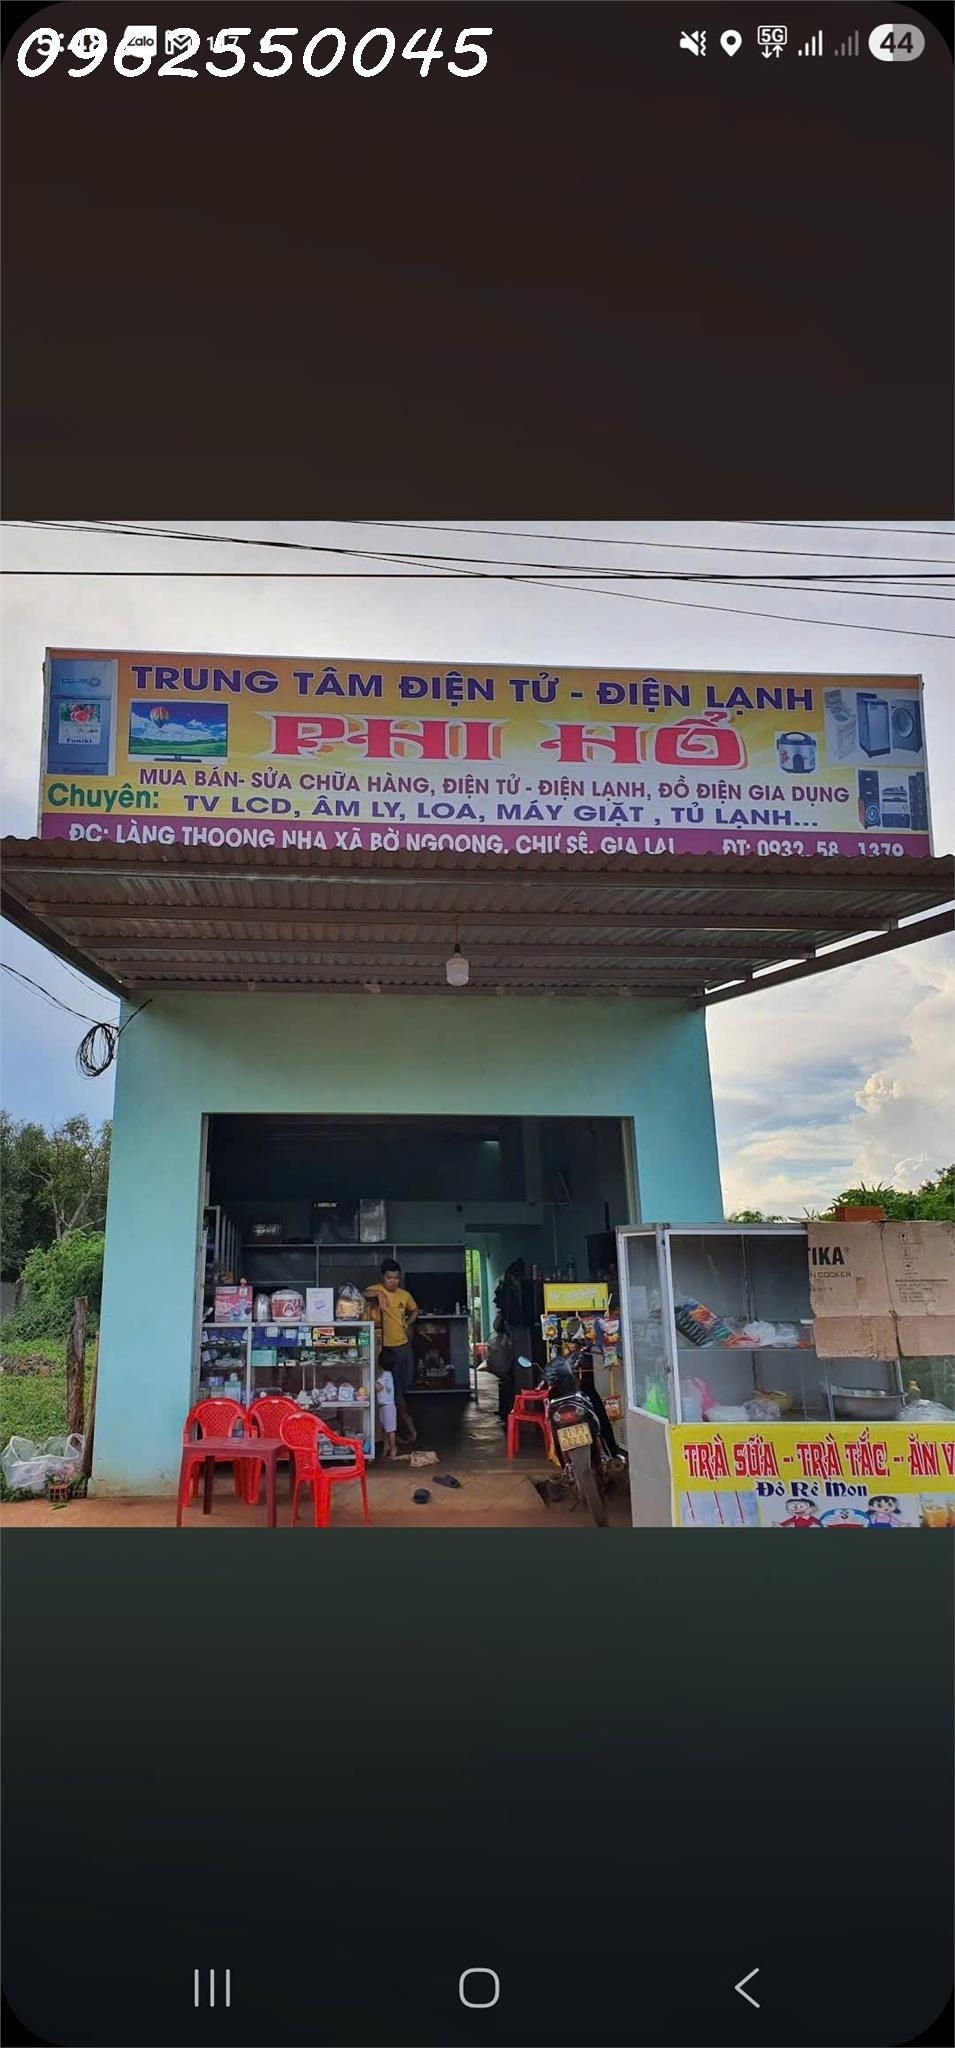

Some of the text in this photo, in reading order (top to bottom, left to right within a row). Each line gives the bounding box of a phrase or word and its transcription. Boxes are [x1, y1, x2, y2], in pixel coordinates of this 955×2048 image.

[131, 665, 279, 694] TRUNG
[293, 666, 383, 698] TÂM
[399, 670, 494, 707] ĐIỆN
[509, 672, 560, 702] TỬ
[596, 677, 691, 713] ĐIỆN
[706, 685, 813, 716] LẠNH
[271, 711, 744, 767] PHI HỔ
[47, 783, 159, 813] Chuyên:
[183, 795, 221, 812] TV
[231, 796, 301, 818] LCD,
[312, 795, 360, 817] ÂM
[371, 801, 406, 821] LY,
[417, 802, 485, 823] LOA,
[496, 800, 563, 821] MÁY
[573, 802, 644, 826] GIẶT
[670, 802, 704, 823] TỦ
[140, 768, 187, 785] MUA
[251, 767, 292, 789] SỬA
[299, 771, 360, 792] CHỮA
[367, 772, 435, 796] HÀNG,
[443, 774, 489, 798] ĐIỆN
[496, 774, 521, 795] TỬ
[538, 776, 584, 800] ĐIỆN
[592, 781, 651, 801] LẠNH,
[658, 775, 689, 799] ĐỒ
[696, 780, 742, 804] ĐIỆN
[749, 785, 786, 801] GIA
[792, 785, 850, 807] DỤNG
[116, 819, 175, 845] LÀNG
[181, 826, 275, 848] THOONG
[282, 829, 327, 850] NHA
[335, 827, 363, 851] XÃ
[371, 827, 400, 852] BỜ
[600, 836, 639, 855] GIA
[645, 837, 675, 855] LAI
[808, 1246, 845, 1265] IKA
[683, 1433, 731, 1480] TRÀ
[734, 1434, 780, 1477] SỮA
[796, 1433, 844, 1480] TRÀ
[844, 1427, 890, 1477] TẮC
[907, 1433, 941, 1477] ĂN
[755, 1481, 869, 1498] Đô Rê Mon
